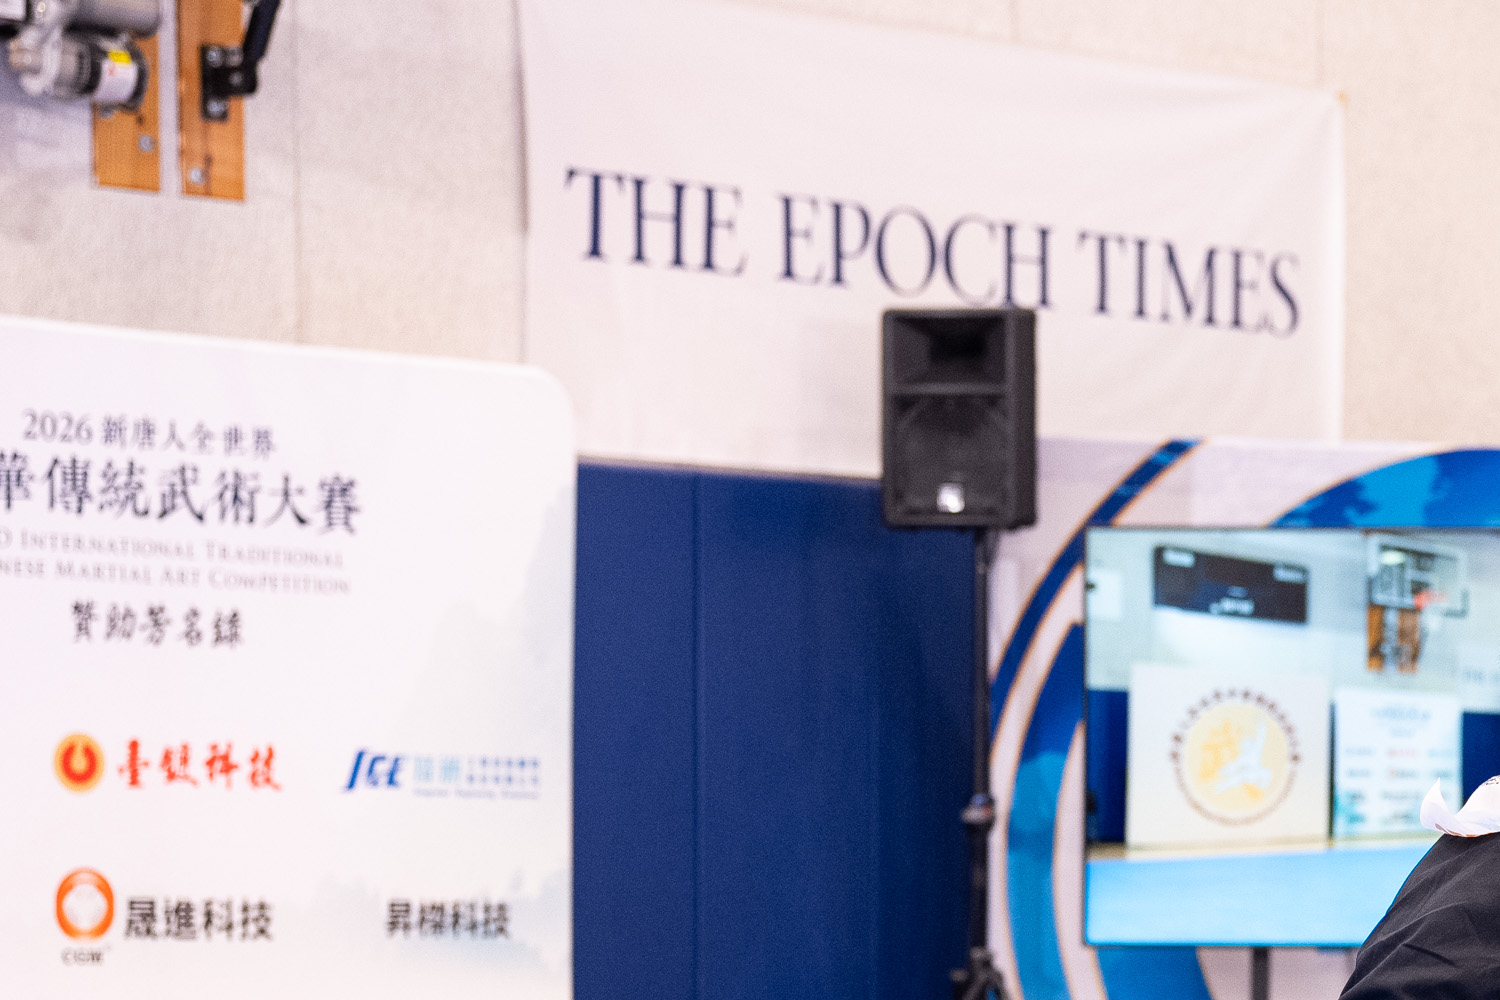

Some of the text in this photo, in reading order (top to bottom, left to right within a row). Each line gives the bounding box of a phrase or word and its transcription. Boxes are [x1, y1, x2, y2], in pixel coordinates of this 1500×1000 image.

[564, 167, 1302, 339] THE EPOCH TIMES
[22, 408, 277, 459] 2026 新唐人全世界
